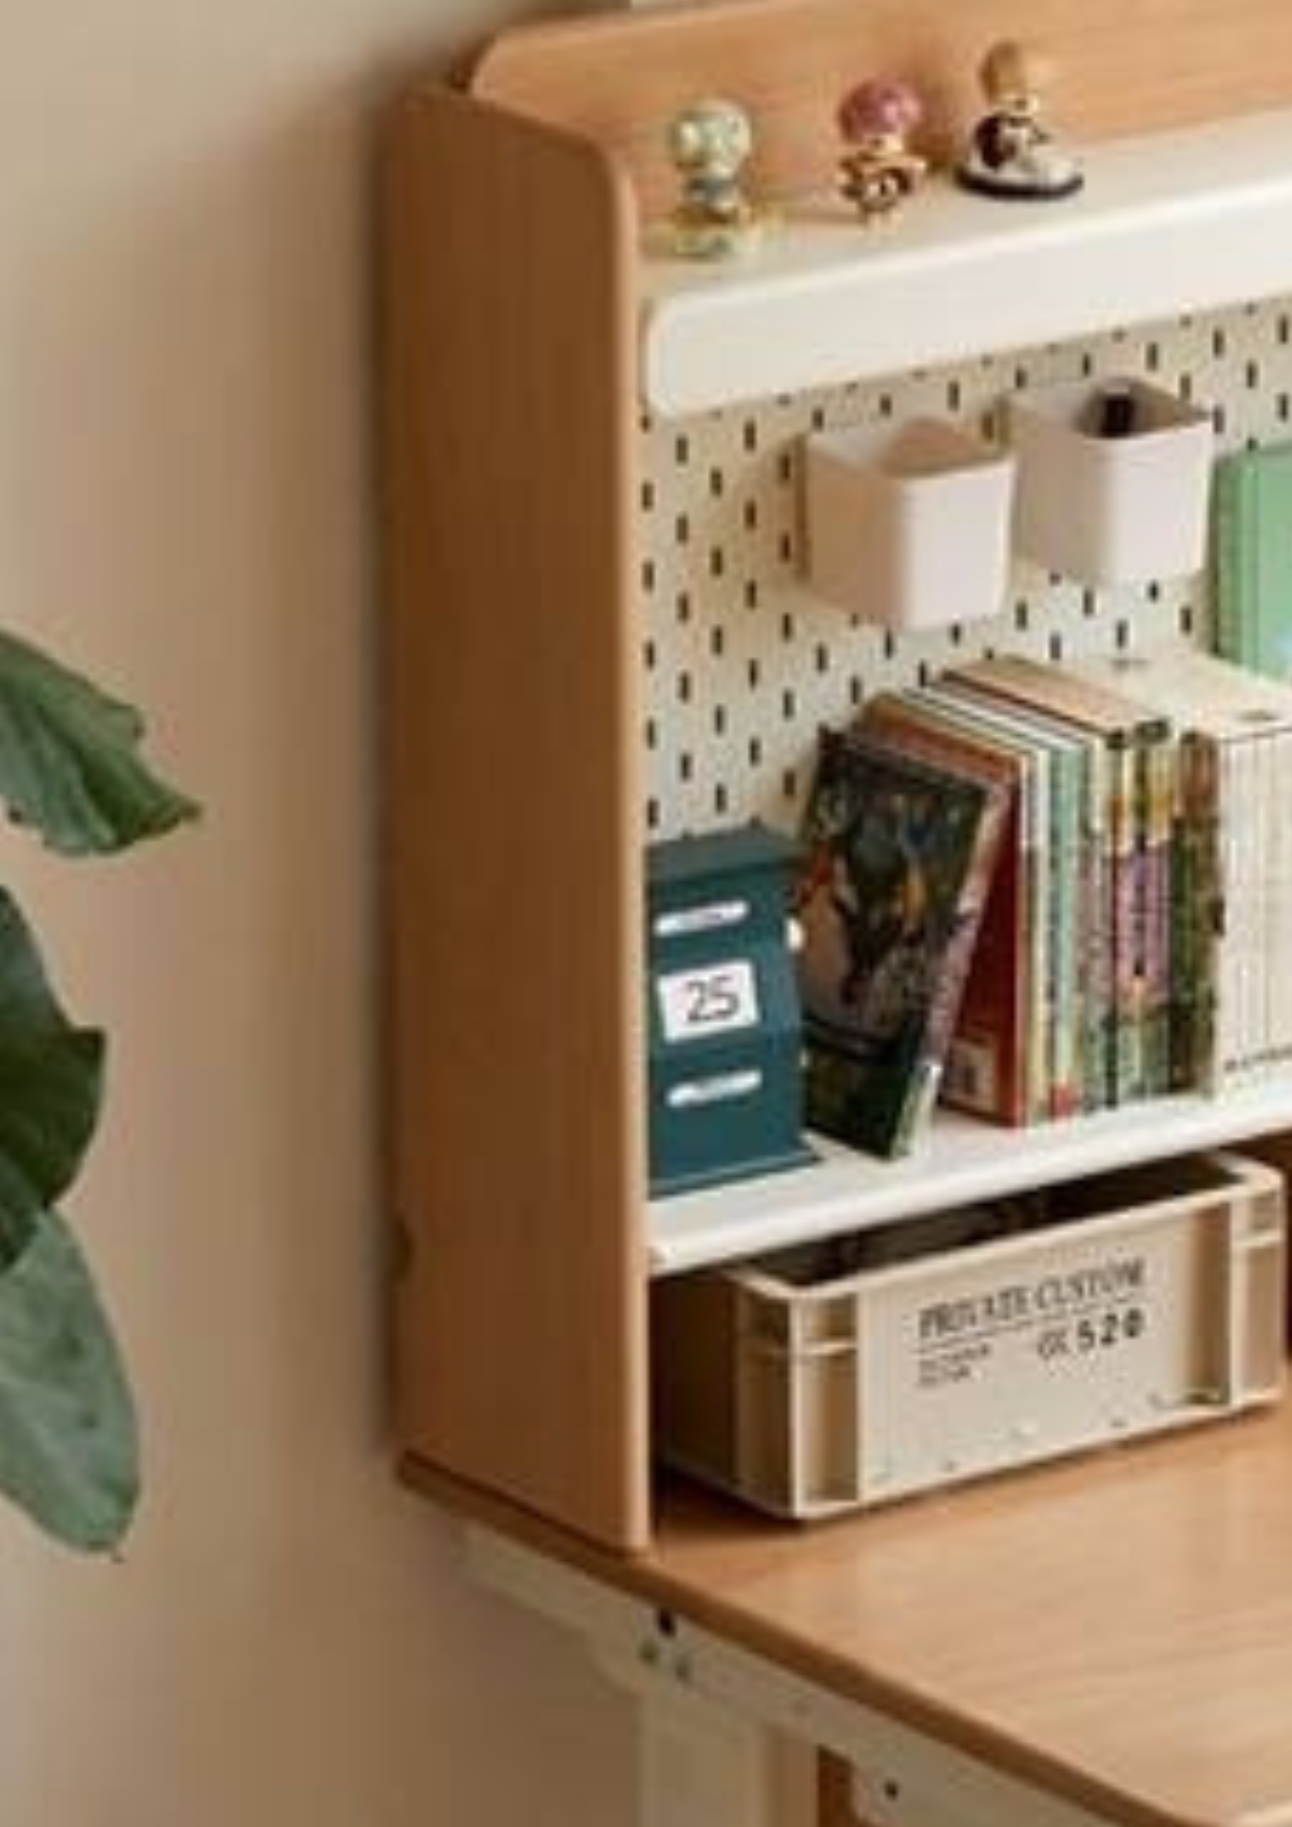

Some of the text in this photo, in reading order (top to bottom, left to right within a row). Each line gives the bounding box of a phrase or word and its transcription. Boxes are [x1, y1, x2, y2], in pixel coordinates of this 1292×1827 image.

[685, 973, 741, 1023] 25
[918, 1259, 1143, 1339] PRIVATE CUSTOM
[1077, 1307, 1143, 1354] 520
